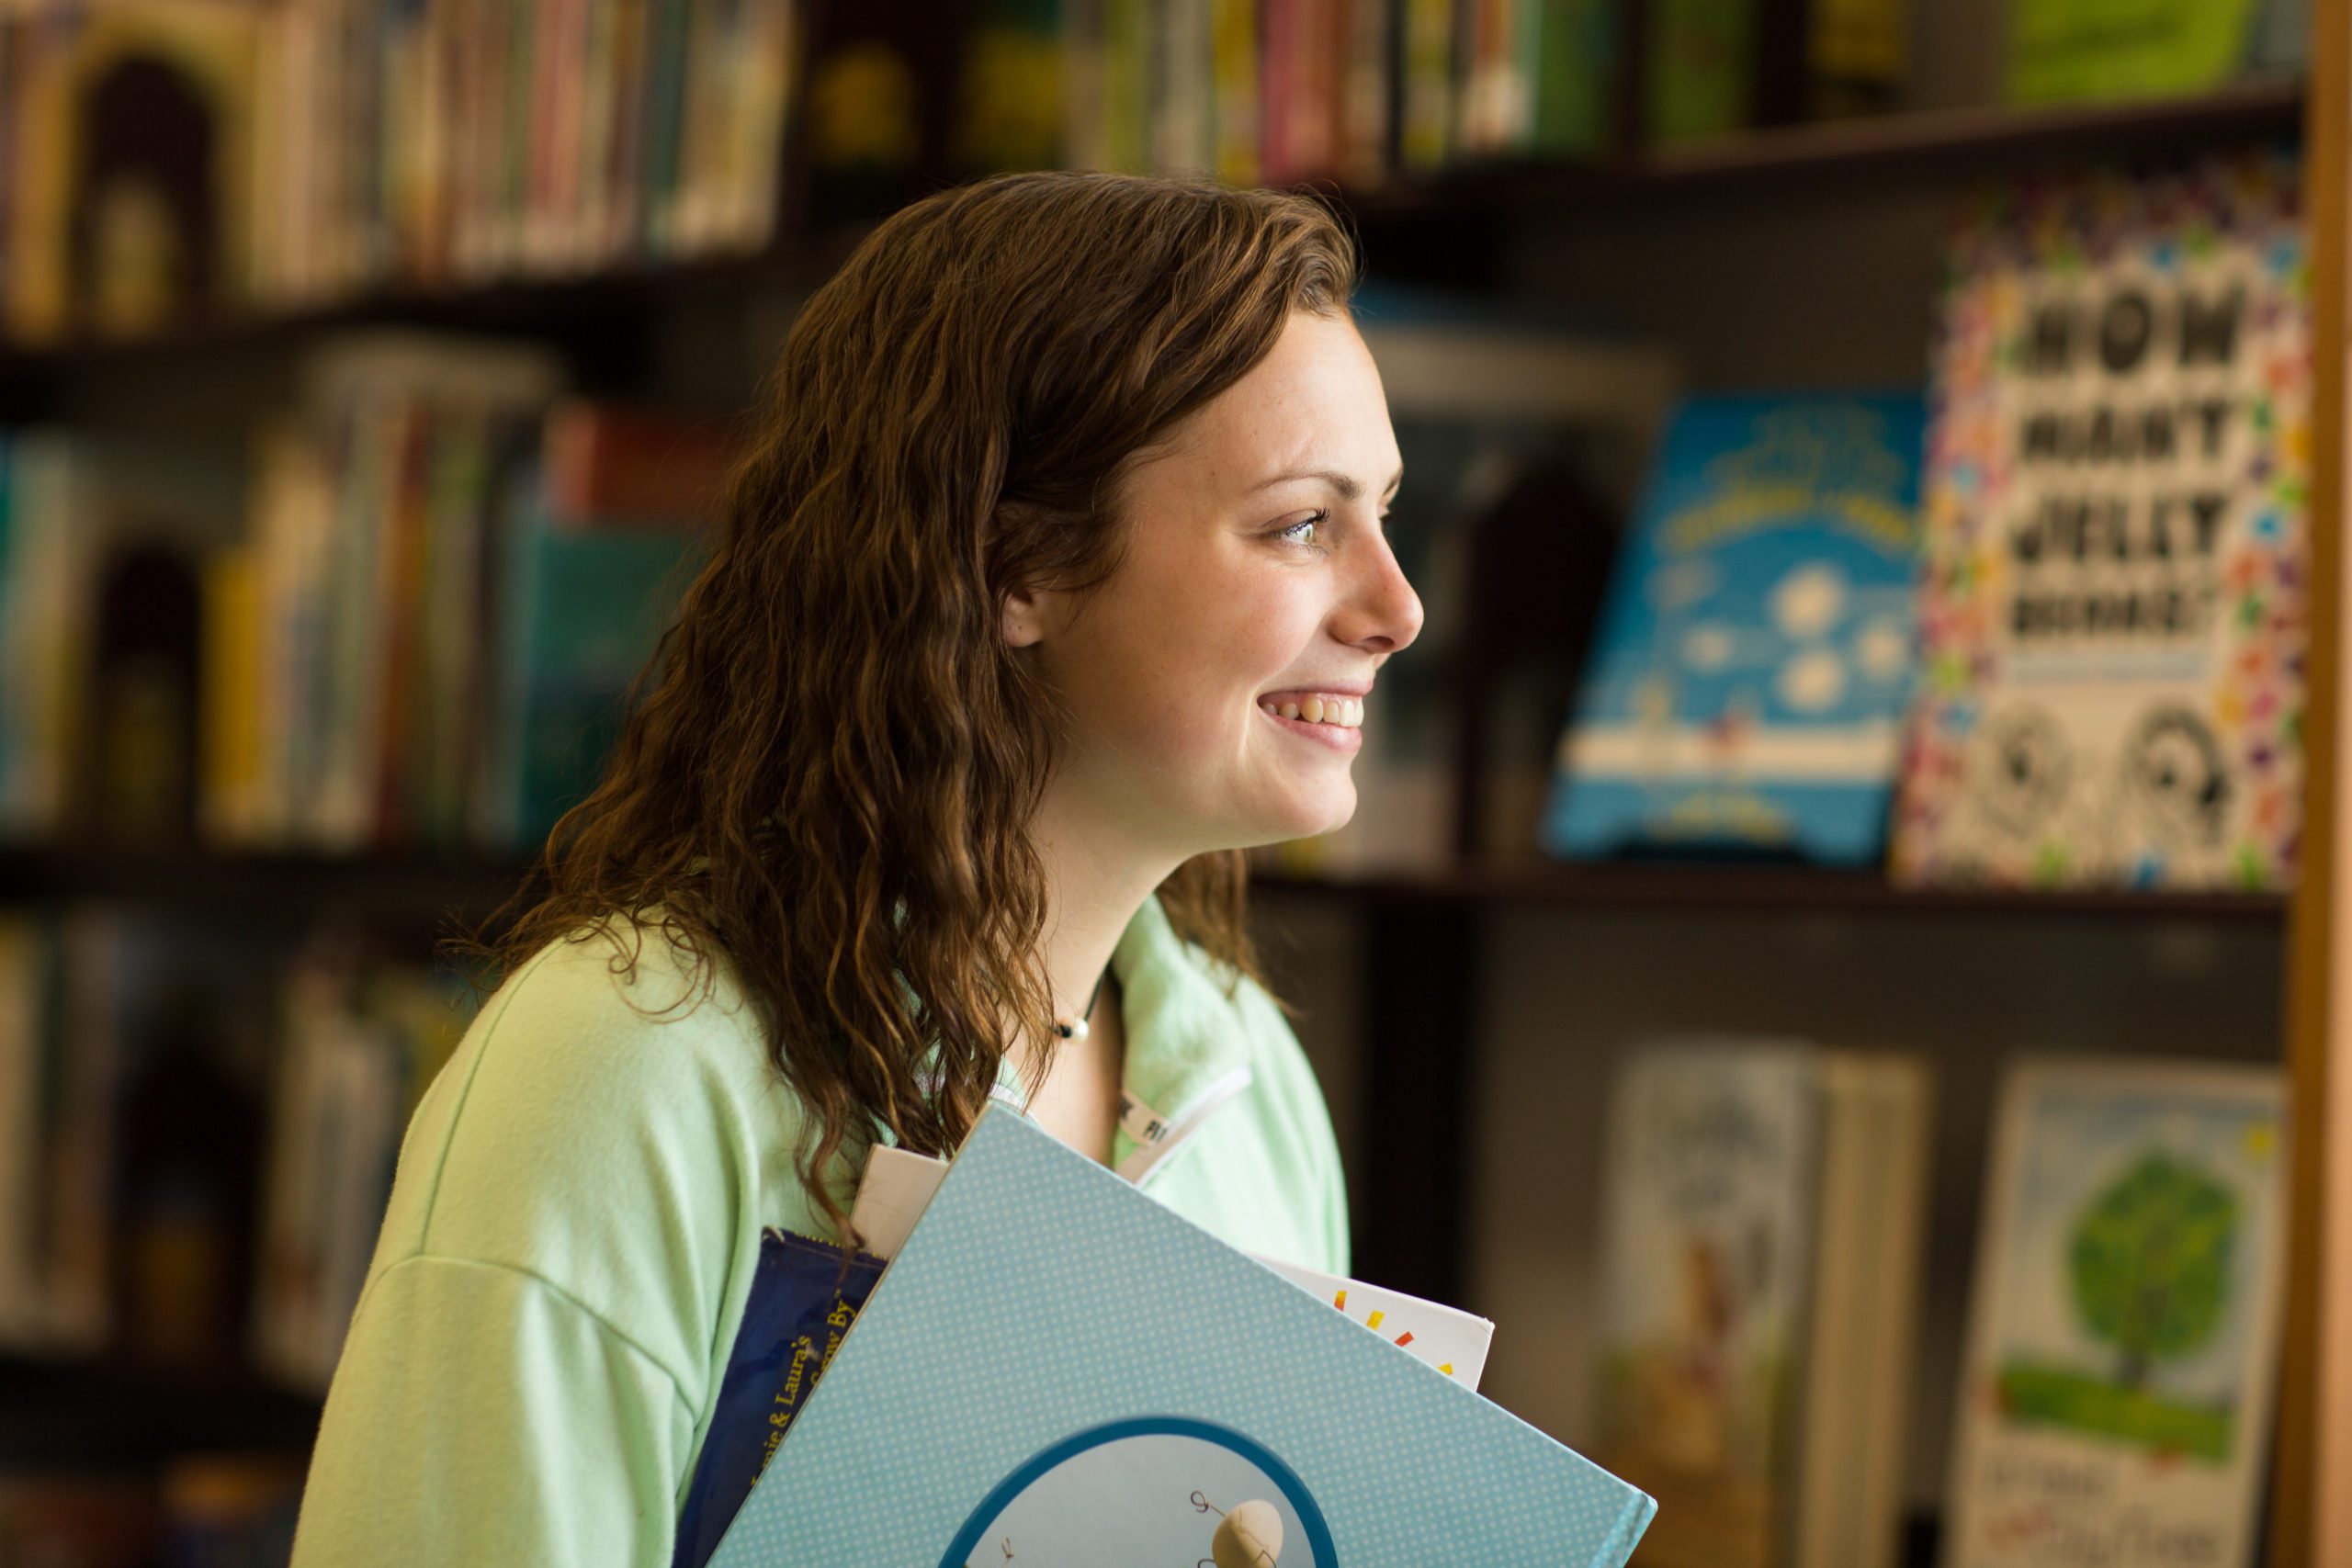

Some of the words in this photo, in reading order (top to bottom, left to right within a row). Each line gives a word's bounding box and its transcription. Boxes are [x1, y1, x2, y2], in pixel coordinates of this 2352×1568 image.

[2021, 280, 2245, 376] HOW
[774, 1335, 812, 1406] Laura's
[769, 1412, 792, 1428] &
[750, 1430, 783, 1486] mie
